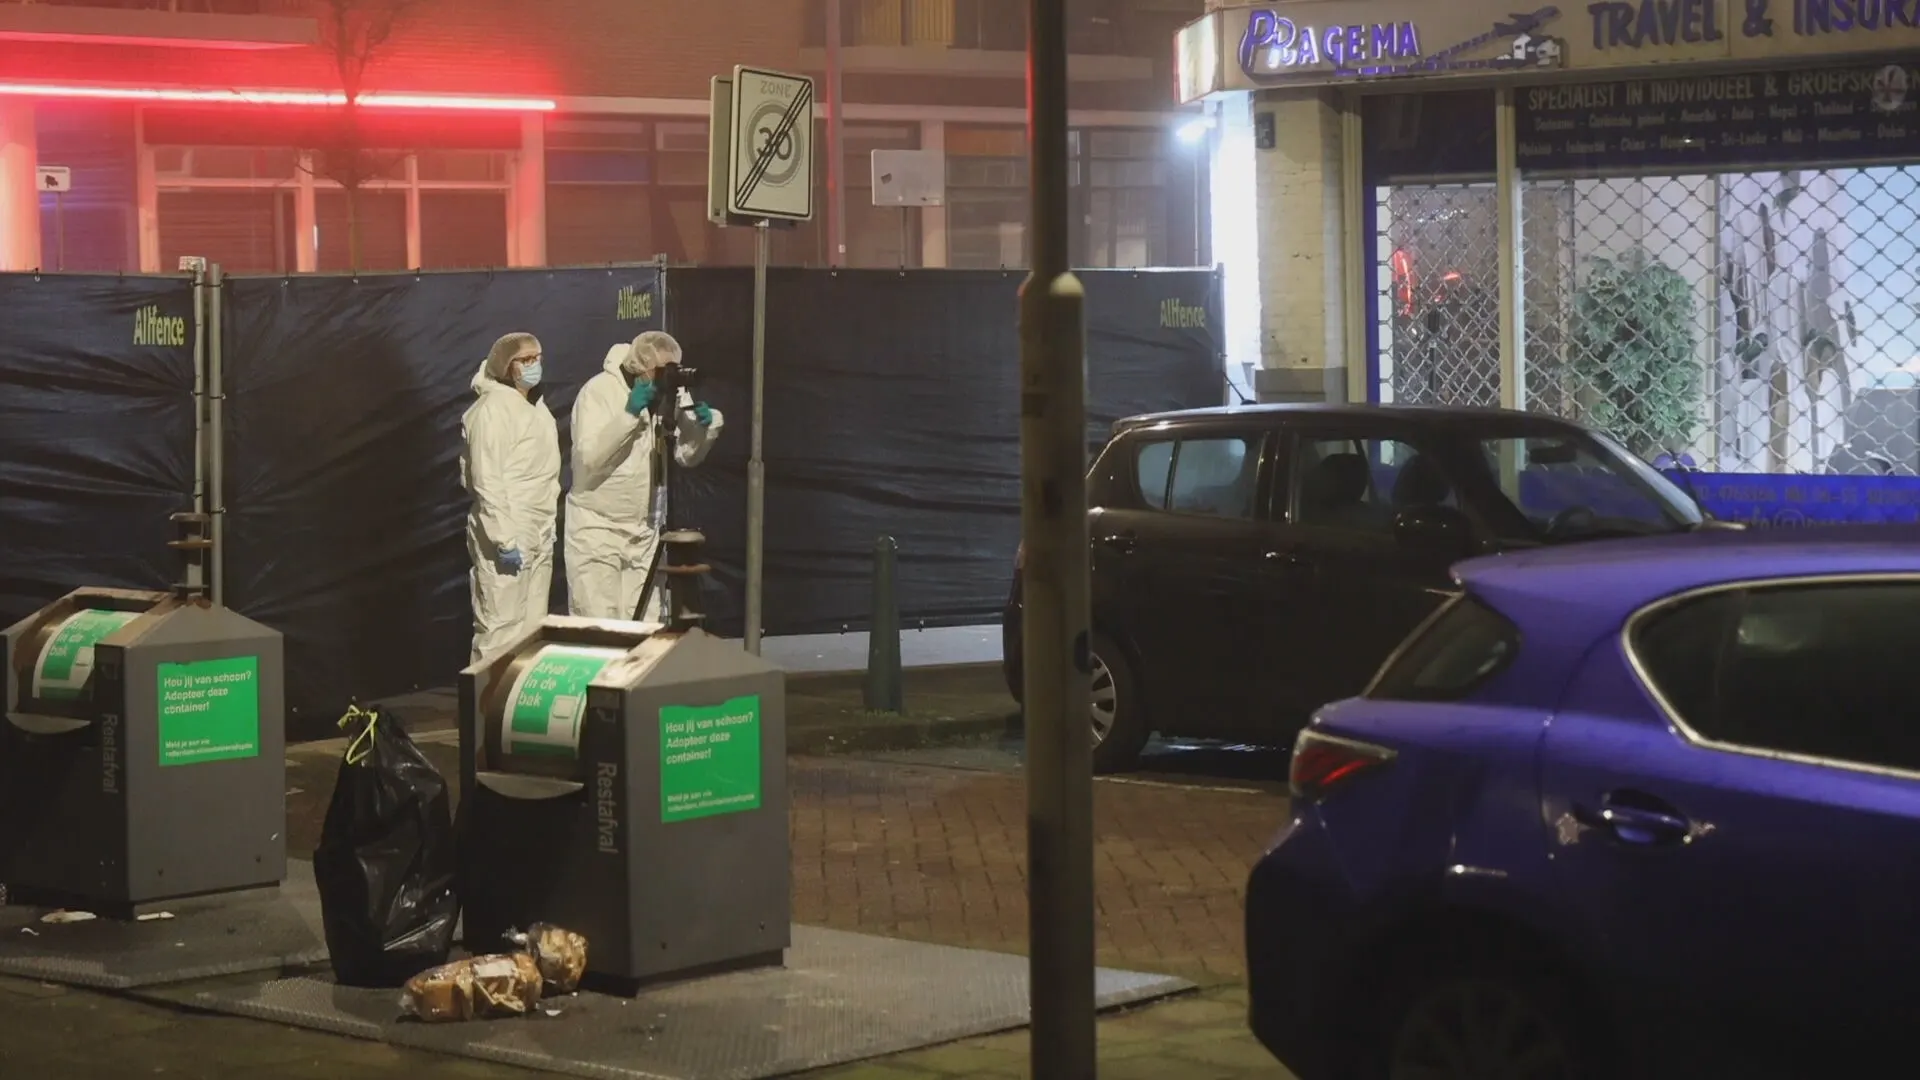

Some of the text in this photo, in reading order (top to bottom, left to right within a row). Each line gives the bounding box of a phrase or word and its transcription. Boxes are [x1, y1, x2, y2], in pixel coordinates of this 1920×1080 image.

[1588, 0, 1723, 50] TRAVEL
[1742, 0, 1773, 38] &
[760, 80, 792, 98] ZONE
[1528, 85, 1616, 111] SPECIALIST
[1626, 82, 1643, 105] IN
[1651, 75, 1755, 105] INDIVIDUEEL
[1763, 76, 1780, 98] &
[756, 126, 793, 160] 30
[617, 285, 651, 320] Allfence
[1160, 298, 1205, 328] Allfence
[133, 304, 184, 346] Allfence
[534, 661, 568, 675] Afval
[164, 669, 252, 689] Hou jij van schoon?
[524, 677, 557, 691] in de
[163, 687, 229, 702] Adopteer deze
[517, 691, 542, 708] bak
[164, 701, 210, 714] container!
[665, 711, 754, 734] Hou jij van schoon?
[666, 731, 731, 749] Adopteer deze
[102, 713, 119, 794] Restafval
[666, 748, 712, 765] container!
[597, 762, 619, 854] Restafval
